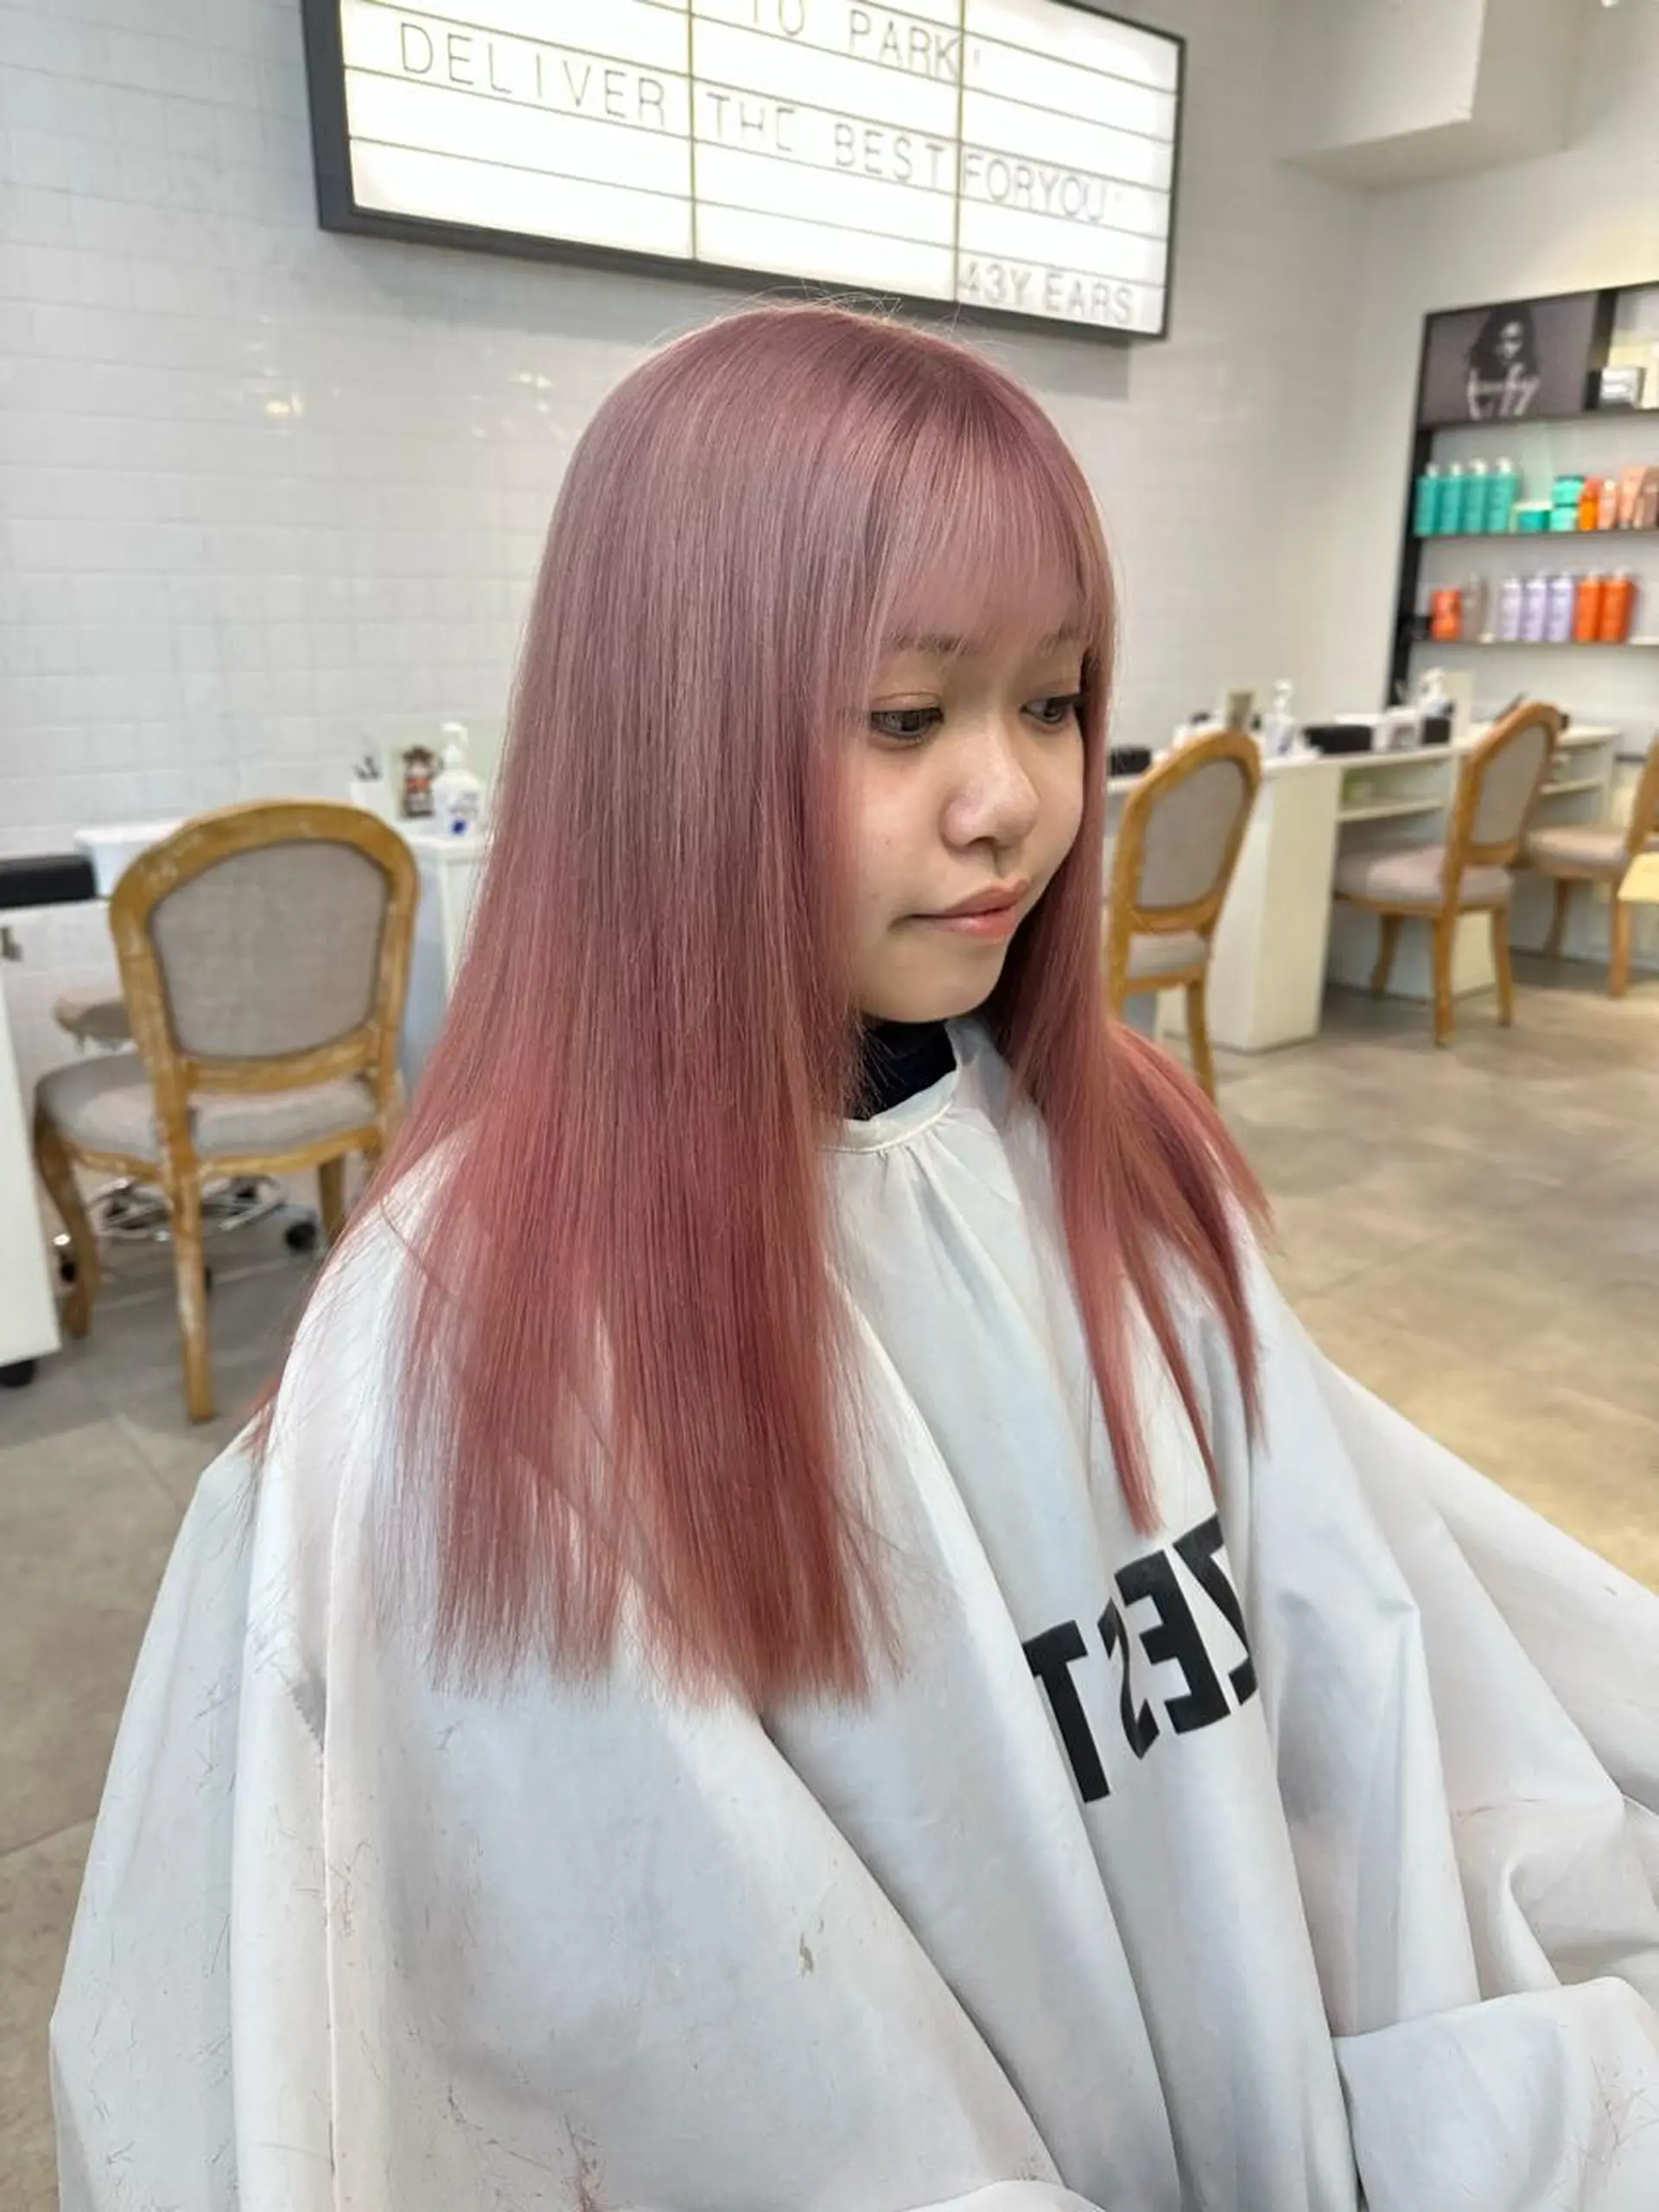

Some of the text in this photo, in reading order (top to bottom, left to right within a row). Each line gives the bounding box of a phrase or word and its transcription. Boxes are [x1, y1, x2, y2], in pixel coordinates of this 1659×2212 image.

[400, 22, 666, 128] DELIVER
[705, 93, 796, 152] THE
[834, 124, 948, 190] BEST
